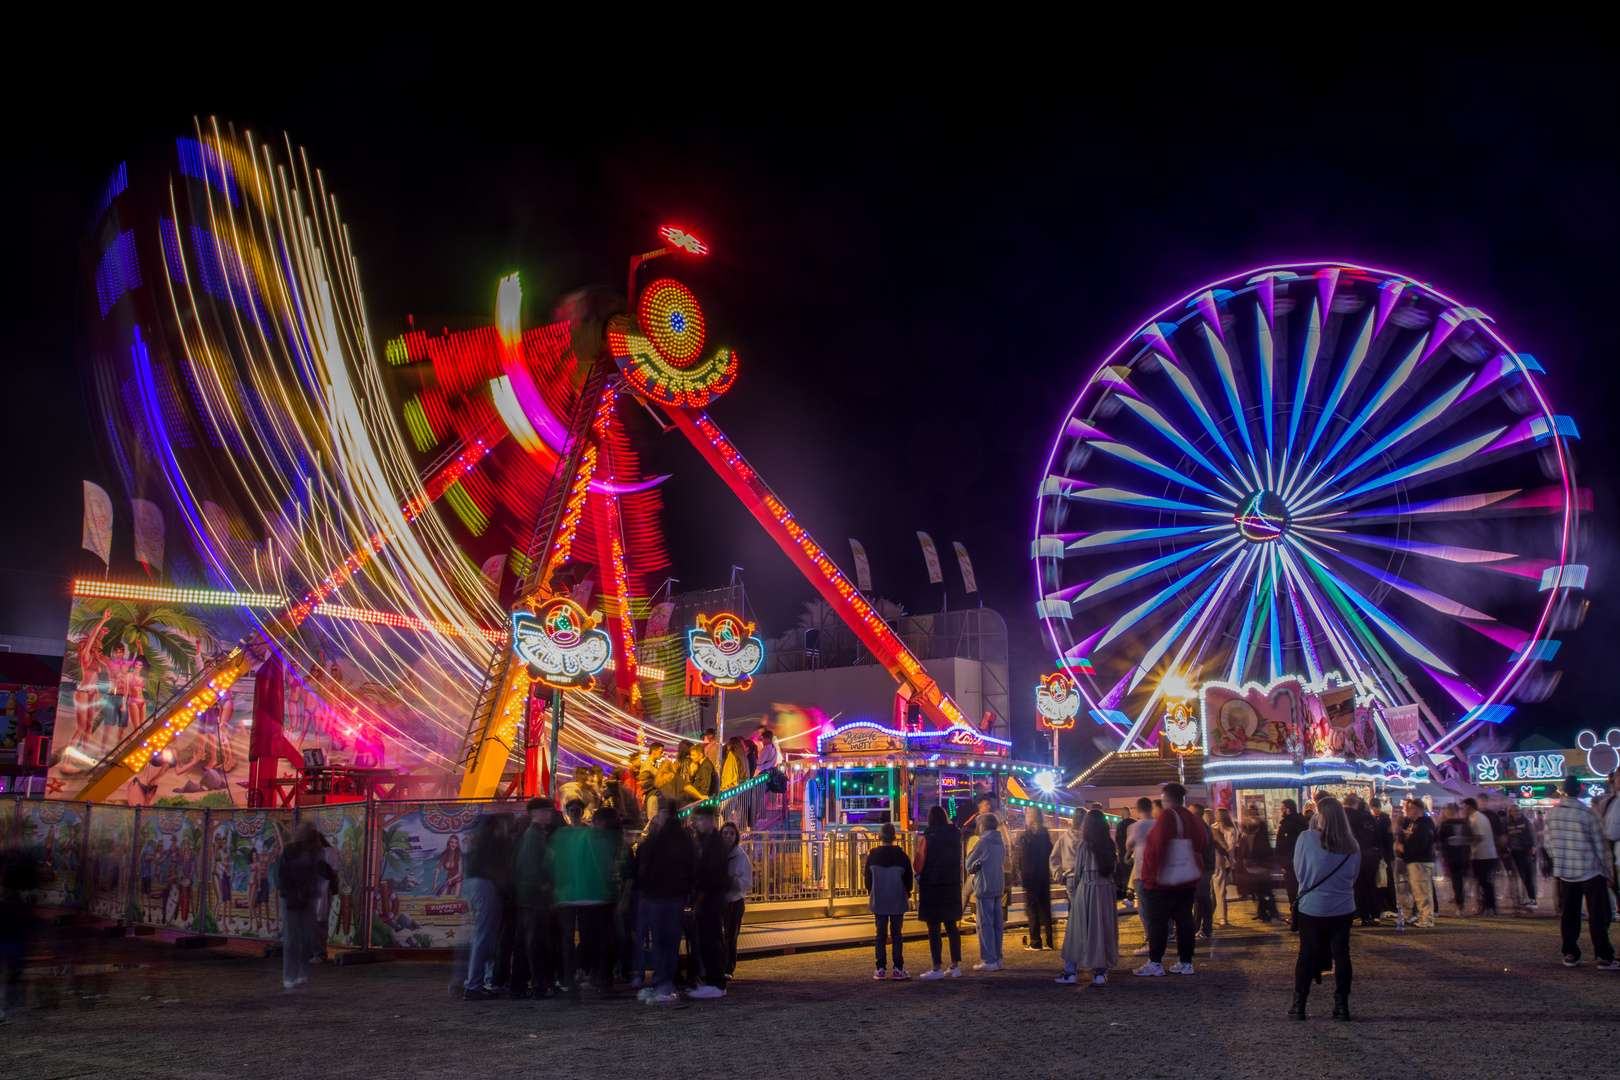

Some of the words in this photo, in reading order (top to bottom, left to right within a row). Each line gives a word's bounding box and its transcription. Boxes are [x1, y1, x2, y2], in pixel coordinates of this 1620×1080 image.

[546, 674, 572, 683] RUPPERT
[1386, 714, 1418, 735] Mandeln
[843, 729, 878, 745] Beach
[850, 742, 872, 751] PARTY
[1513, 754, 1566, 779] PLAY
[943, 778, 956, 786] OPEN
[430, 903, 463, 911] RUPPERT
